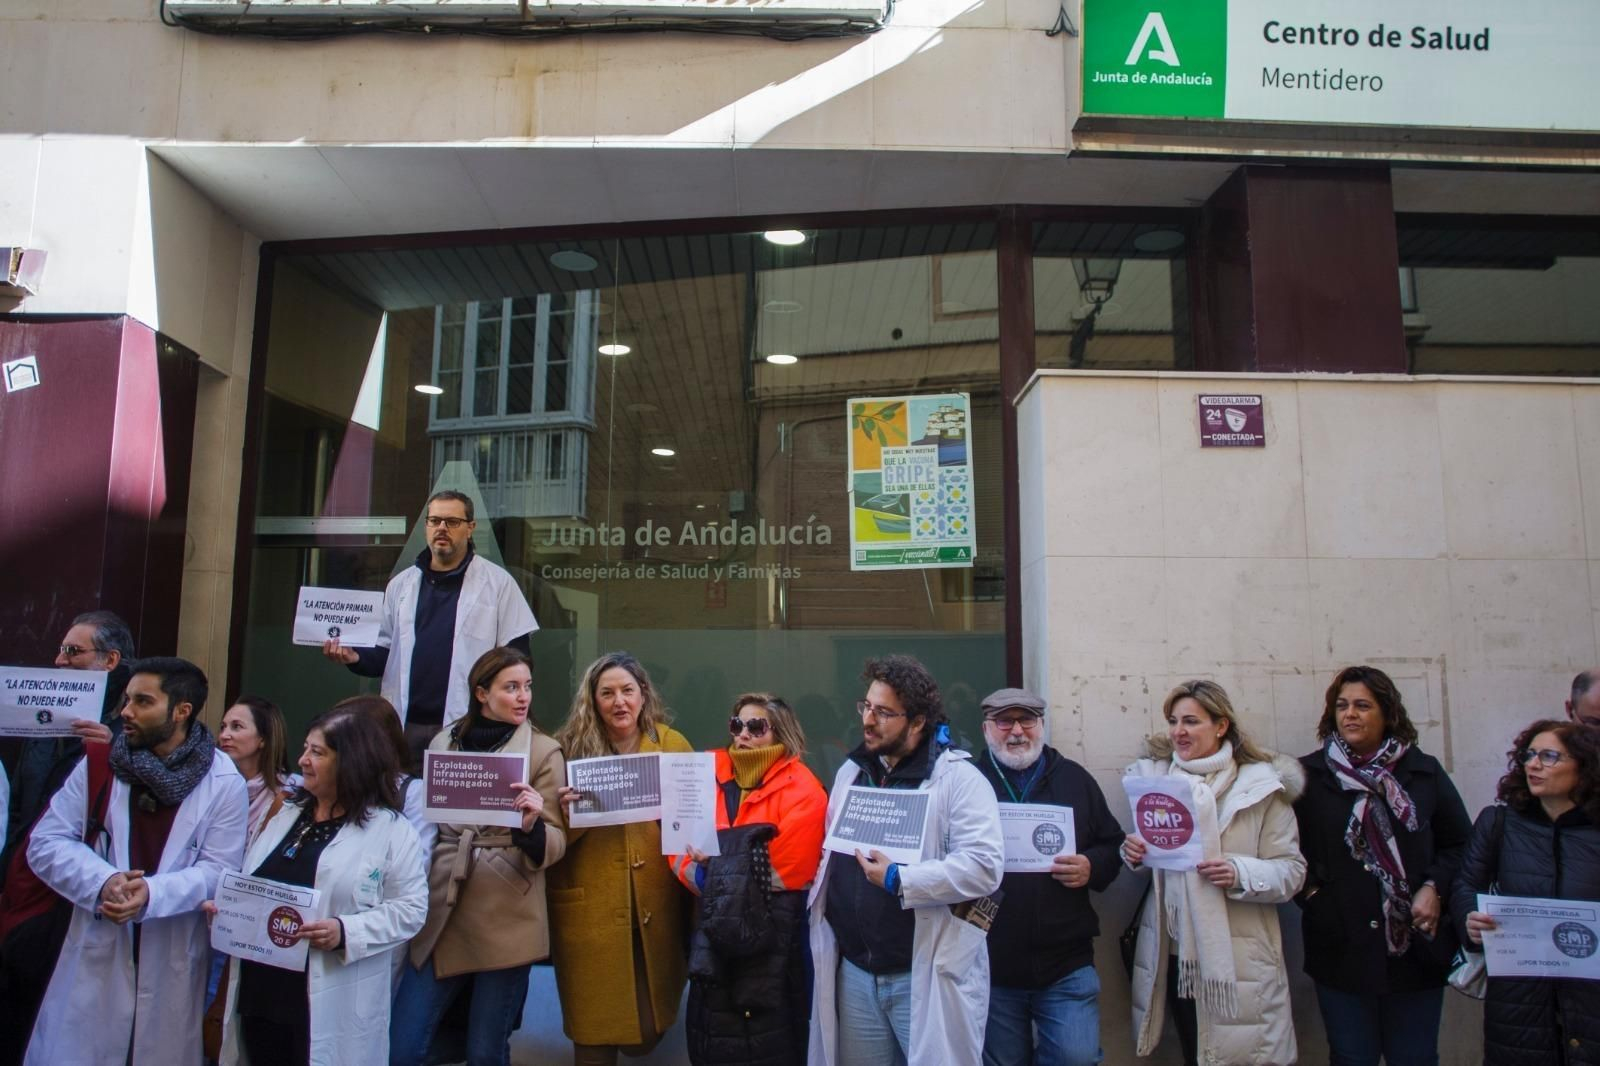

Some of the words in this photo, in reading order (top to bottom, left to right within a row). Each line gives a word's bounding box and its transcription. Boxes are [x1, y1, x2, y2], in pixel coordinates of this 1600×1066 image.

[1262, 20, 1360, 46] Centro
[1368, 22, 1402, 48] de
[1410, 25, 1491, 52] Salud
[1092, 71, 1129, 83] Junta
[1131, 71, 1148, 84] de
[1149, 71, 1213, 86] Andalucía
[1260, 66, 1385, 93] Mentidero
[1211, 433, 1255, 441] CONECTADA
[898, 456, 907, 465] LA
[884, 464, 936, 484] GRIPE
[918, 482, 936, 491] ELLAS
[541, 520, 627, 546] Junta
[634, 519, 672, 546] de
[677, 514, 832, 546] Andalucía
[541, 561, 631, 583] Consejería
[634, 563, 656, 579] de
[660, 563, 709, 579] Salud
[713, 567, 724, 583] y
[728, 562, 802, 579] Familias
[313, 600, 346, 612] ATENCIÓN
[344, 602, 374, 613] PRIMARIA
[313, 613, 323, 622] NO
[323, 613, 345, 624] PUEDE
[19, 678, 58, 691] ATENCIÓN
[58, 681, 96, 693] PRIMARIA
[17, 695, 29, 706] NO
[30, 695, 57, 707] PUEDE
[433, 760, 484, 771] Explotados
[576, 765, 624, 777] Explotados
[432, 769, 499, 780] Infravalorados
[576, 772, 640, 786] Infravalorados
[432, 777, 493, 789] Infrapagados
[577, 780, 634, 793] Infrapagados
[850, 795, 896, 807] Explotados
[847, 803, 908, 817] Infravalorados
[844, 811, 900, 825] Infrapagados
[1143, 810, 1183, 828] SMP
[1036, 831, 1061, 844] SMP
[1152, 835, 1168, 845] 20
[1171, 835, 1180, 845] E
[248, 883, 266, 893] ESTOY
[266, 888, 274, 896] DE
[274, 889, 298, 902] HUELGA
[272, 918, 299, 934] SMP
[273, 936, 284, 945] 20
[284, 938, 291, 946] E
[1558, 931, 1591, 945] SMP
[247, 944, 265, 954] TODOS
